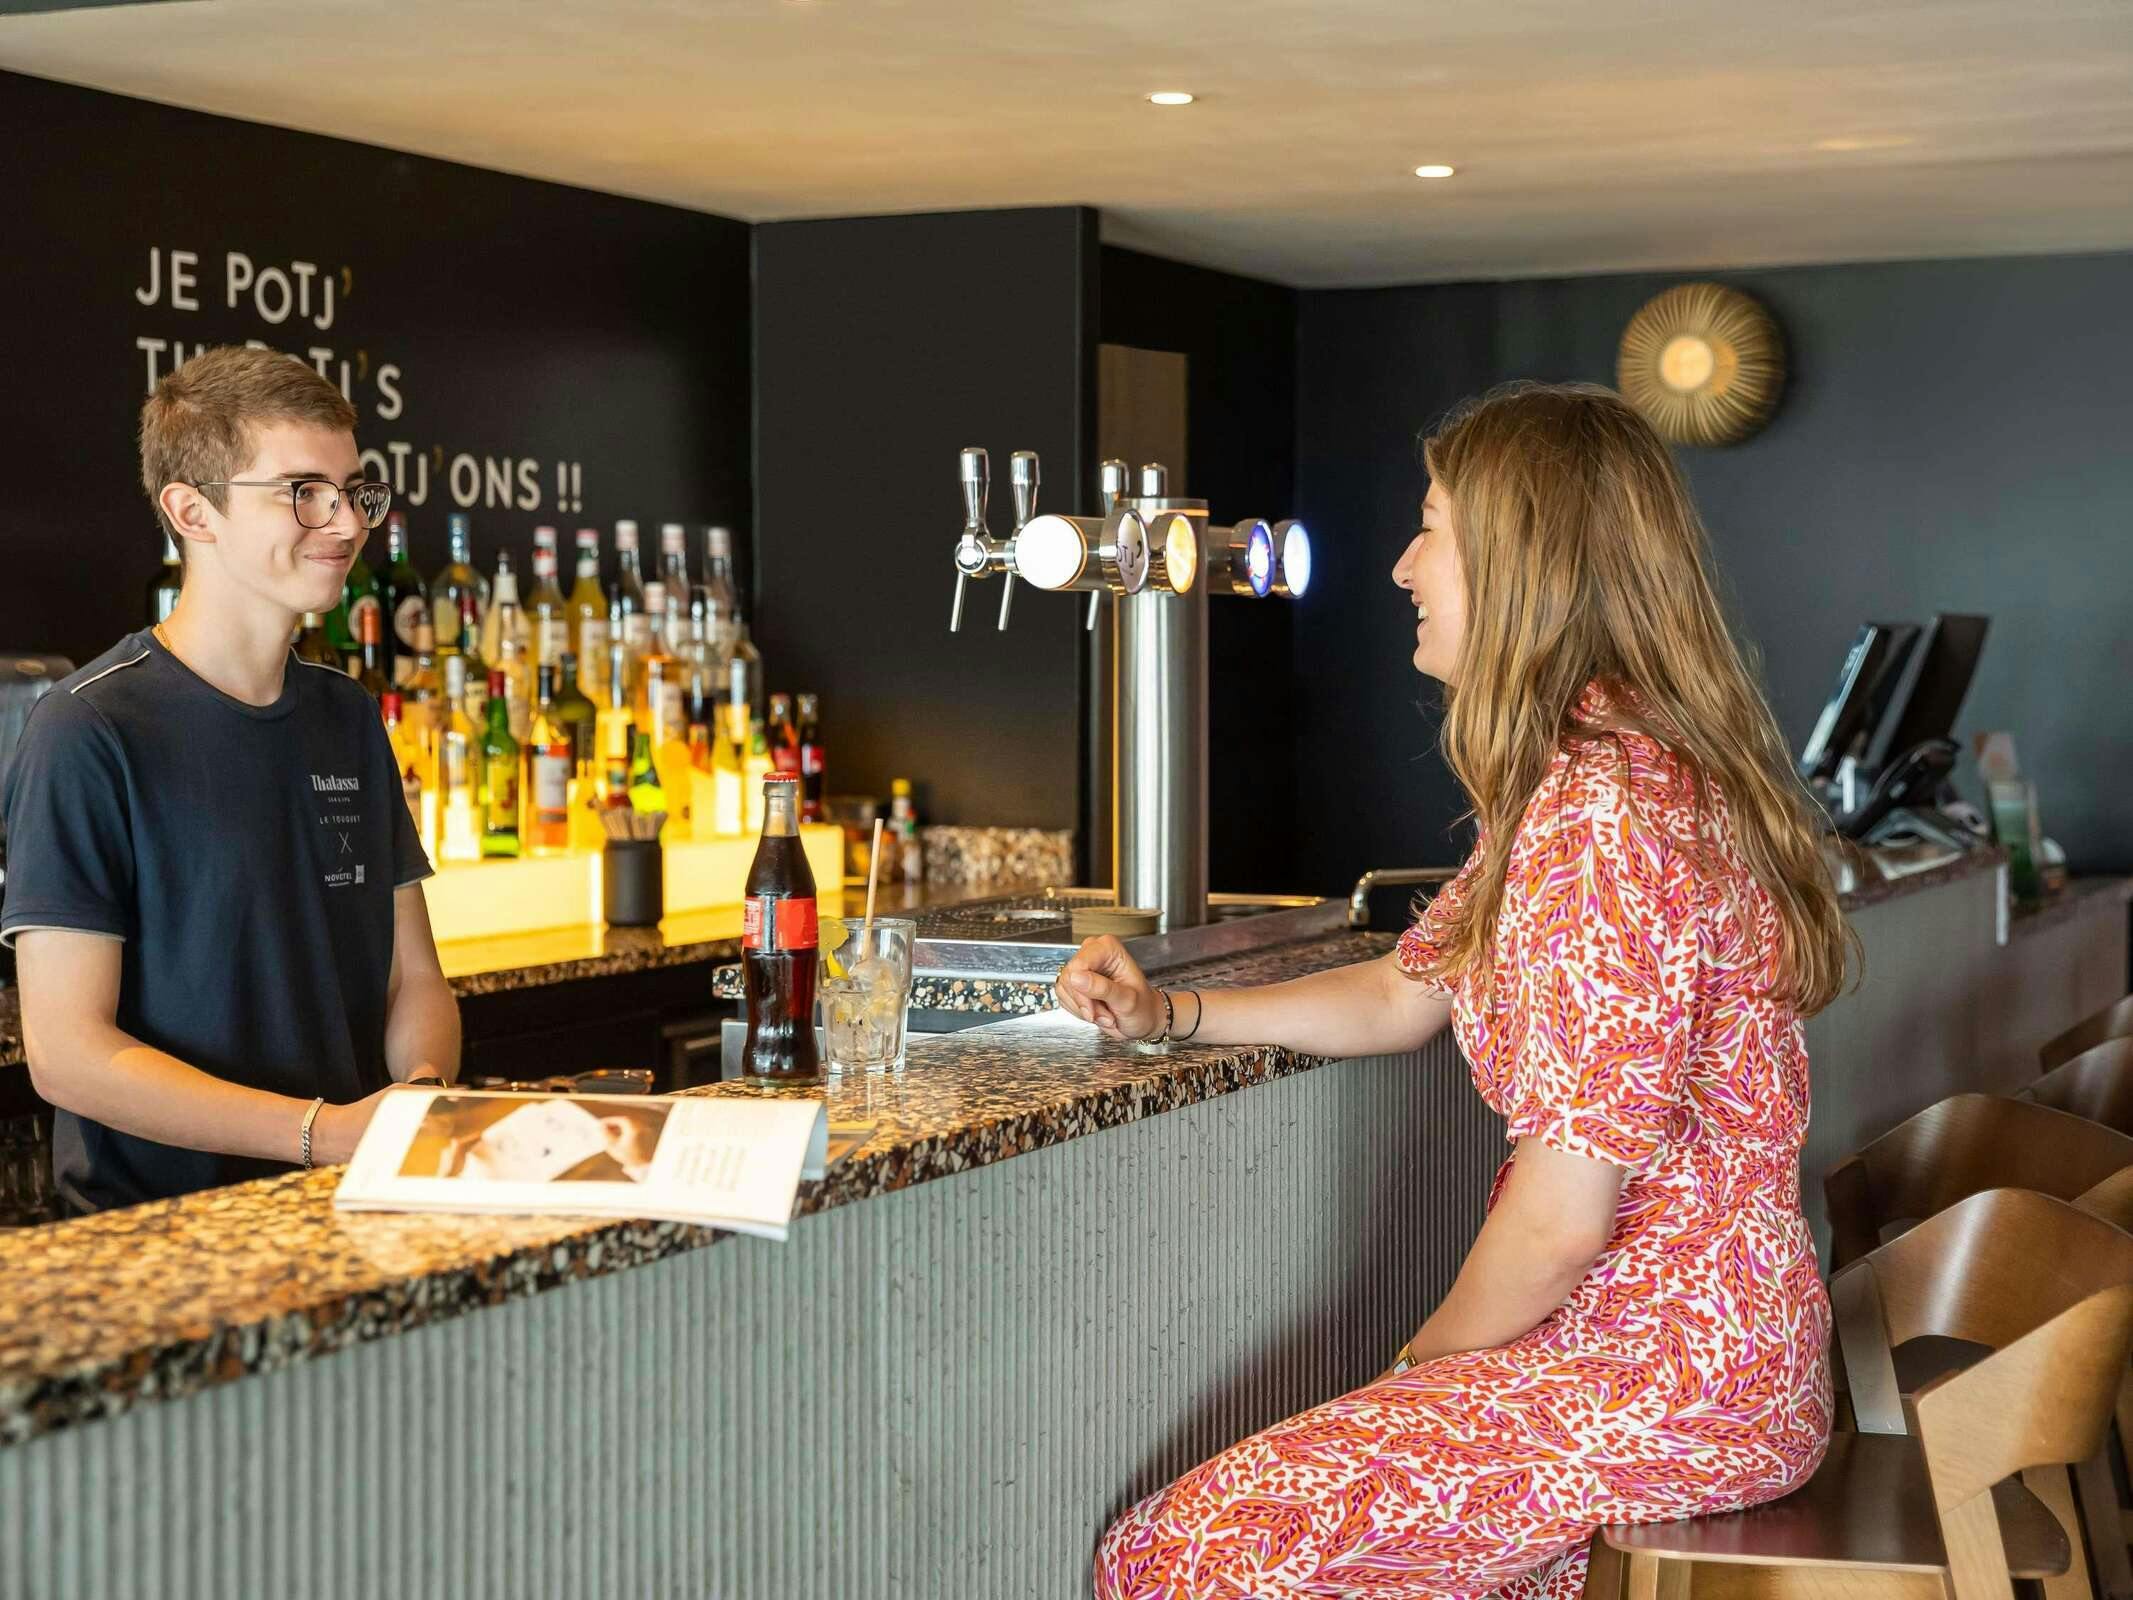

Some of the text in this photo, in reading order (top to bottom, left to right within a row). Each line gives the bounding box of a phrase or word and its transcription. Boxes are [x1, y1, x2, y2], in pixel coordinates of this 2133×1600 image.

[135, 246, 353, 331] JE POTJ'
[310, 774, 360, 792] Thalassa
